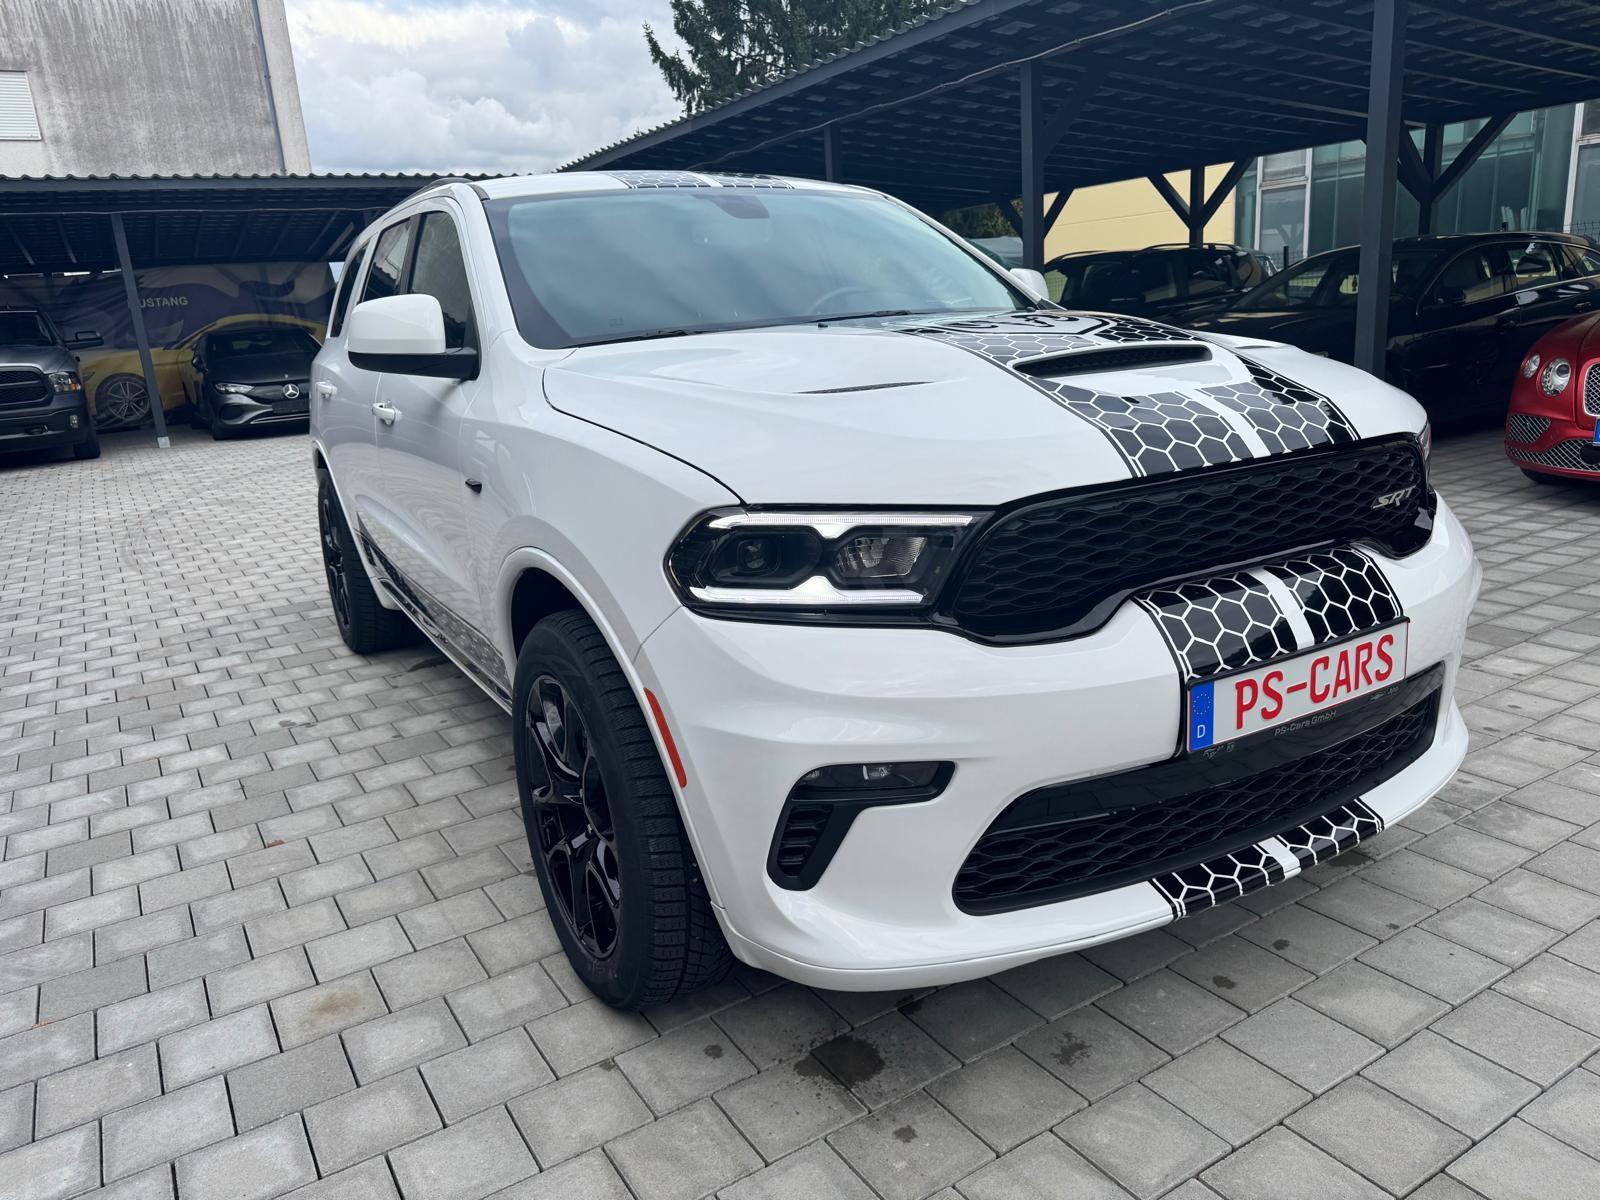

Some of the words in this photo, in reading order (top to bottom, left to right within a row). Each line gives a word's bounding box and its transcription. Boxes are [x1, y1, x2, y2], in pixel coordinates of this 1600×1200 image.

[139, 296, 189, 308] USTANG
[1372, 485, 1416, 509] SRT
[1234, 633, 1394, 730] PS-CARS
[1196, 724, 1206, 739] D
[1274, 719, 1310, 737] PS-Cars
[1311, 710, 1337, 726] GmbH
